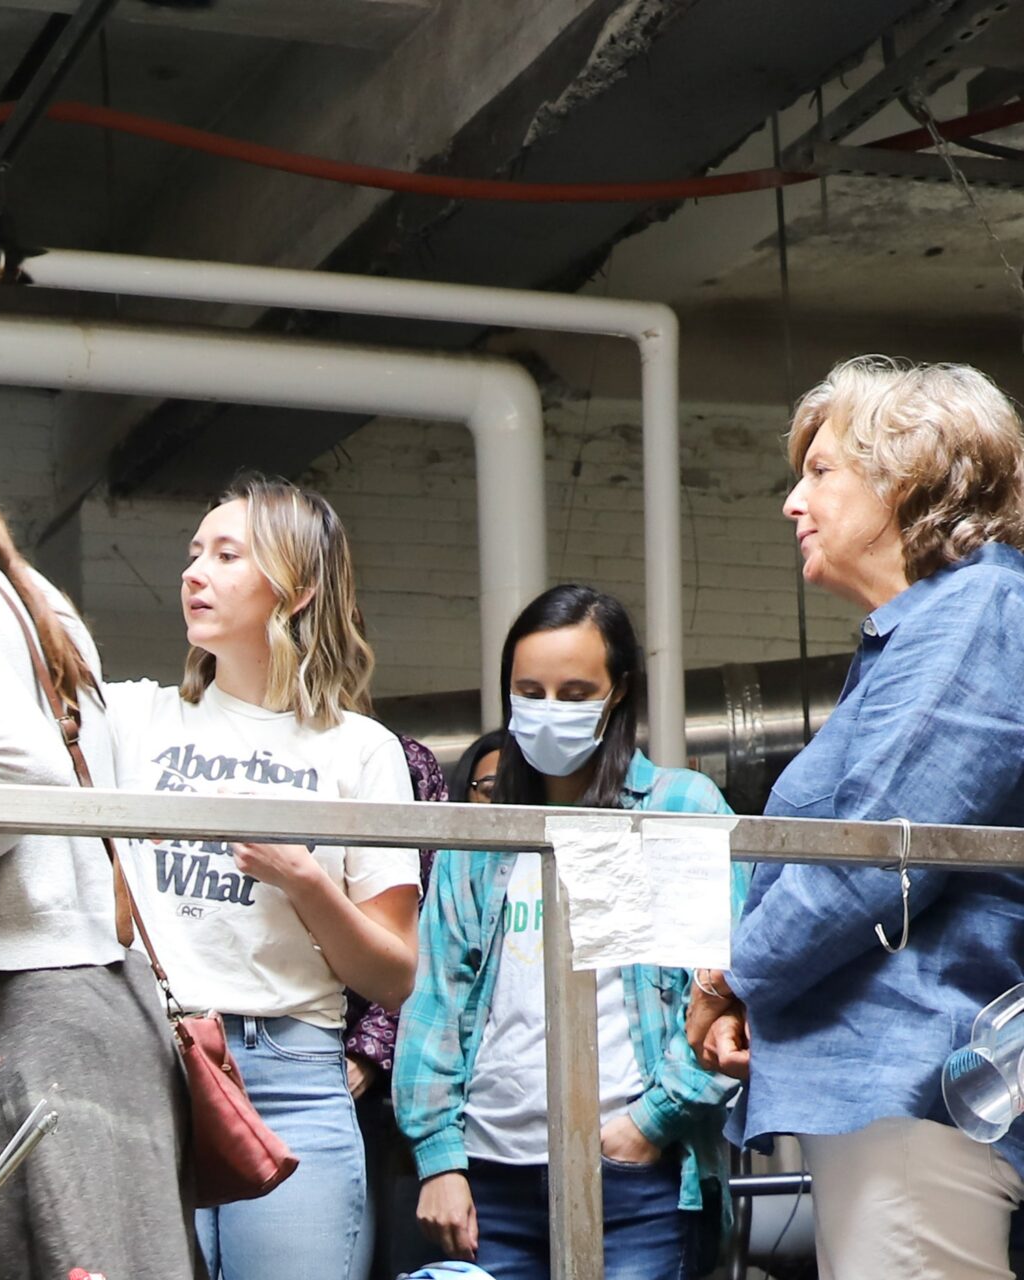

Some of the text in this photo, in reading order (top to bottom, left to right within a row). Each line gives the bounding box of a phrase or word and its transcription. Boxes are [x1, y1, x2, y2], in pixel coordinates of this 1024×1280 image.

[151, 744, 318, 792] Abortion
[153, 849, 259, 906] What
[181, 905, 204, 918] ACT
